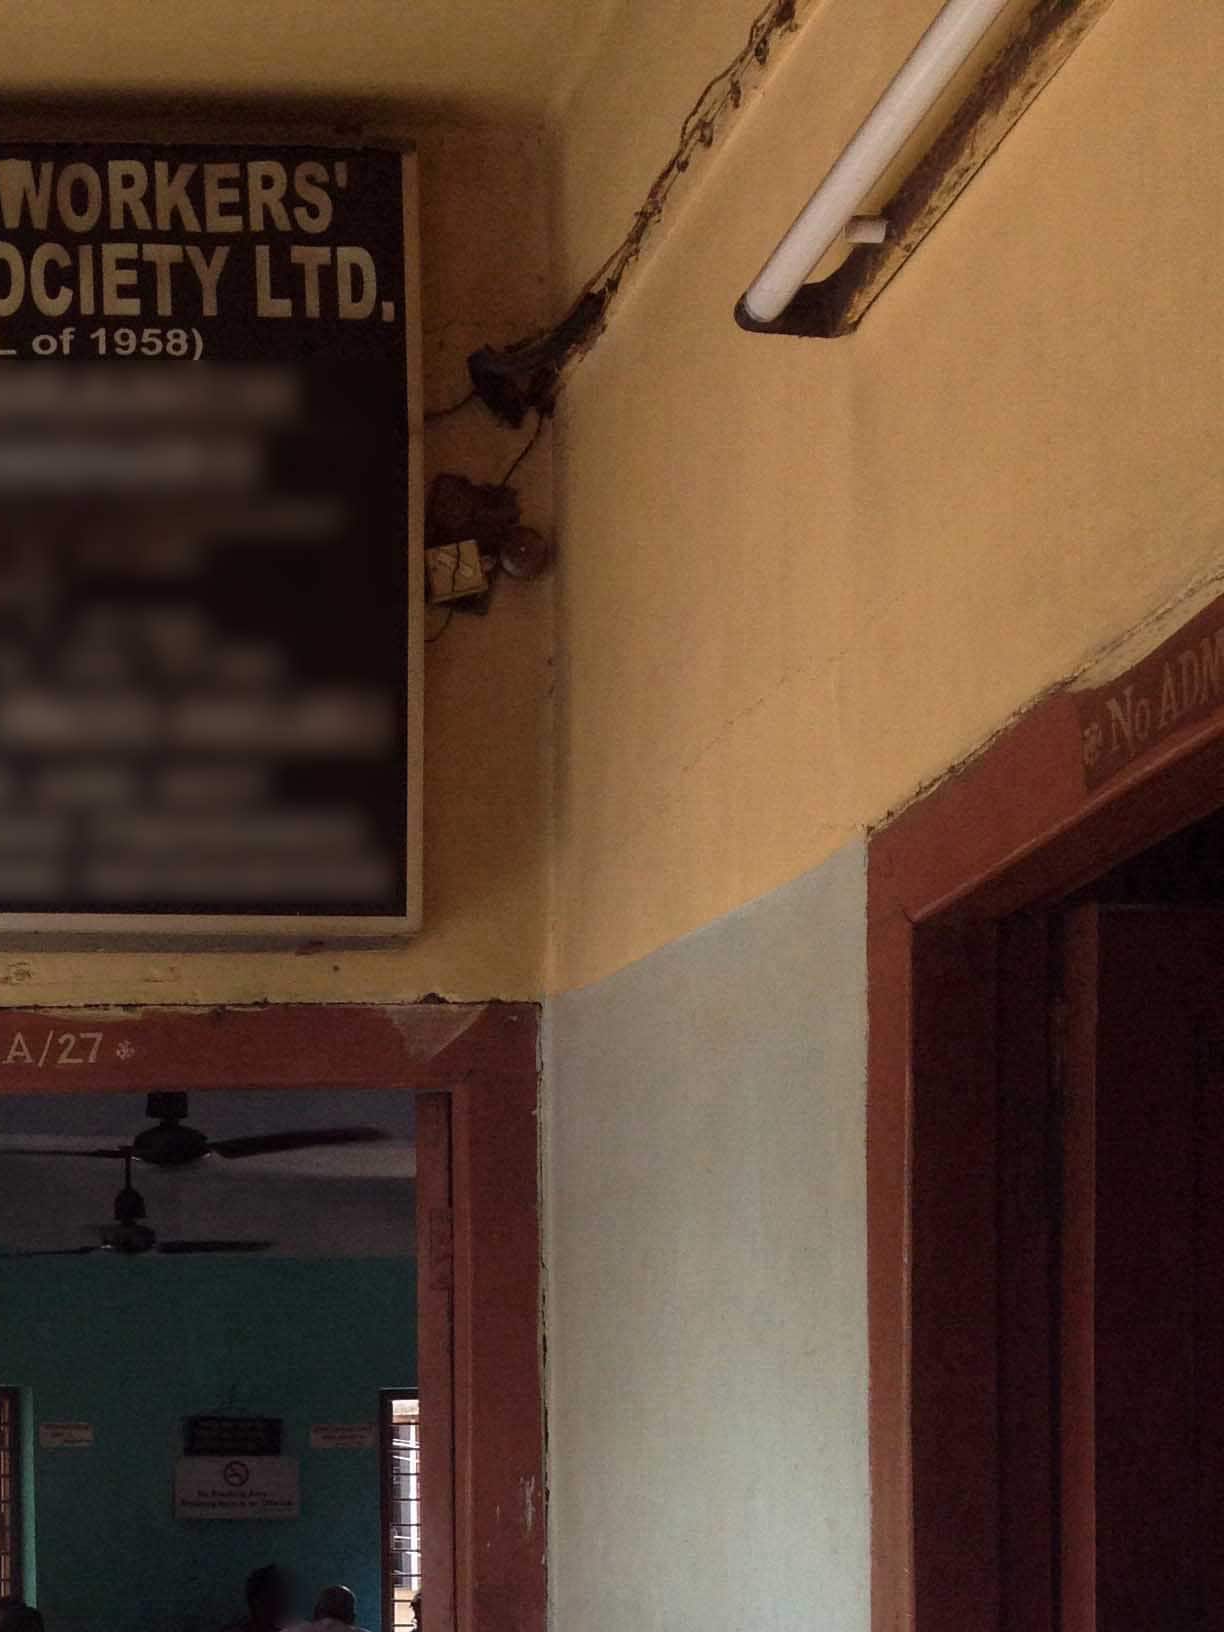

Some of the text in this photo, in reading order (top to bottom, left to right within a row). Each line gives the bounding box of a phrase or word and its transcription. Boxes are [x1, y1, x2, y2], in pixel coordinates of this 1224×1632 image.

[255, 243, 396, 323] LTD.
[31, 328, 76, 357] of
[89, 328, 205, 361] 1958)
